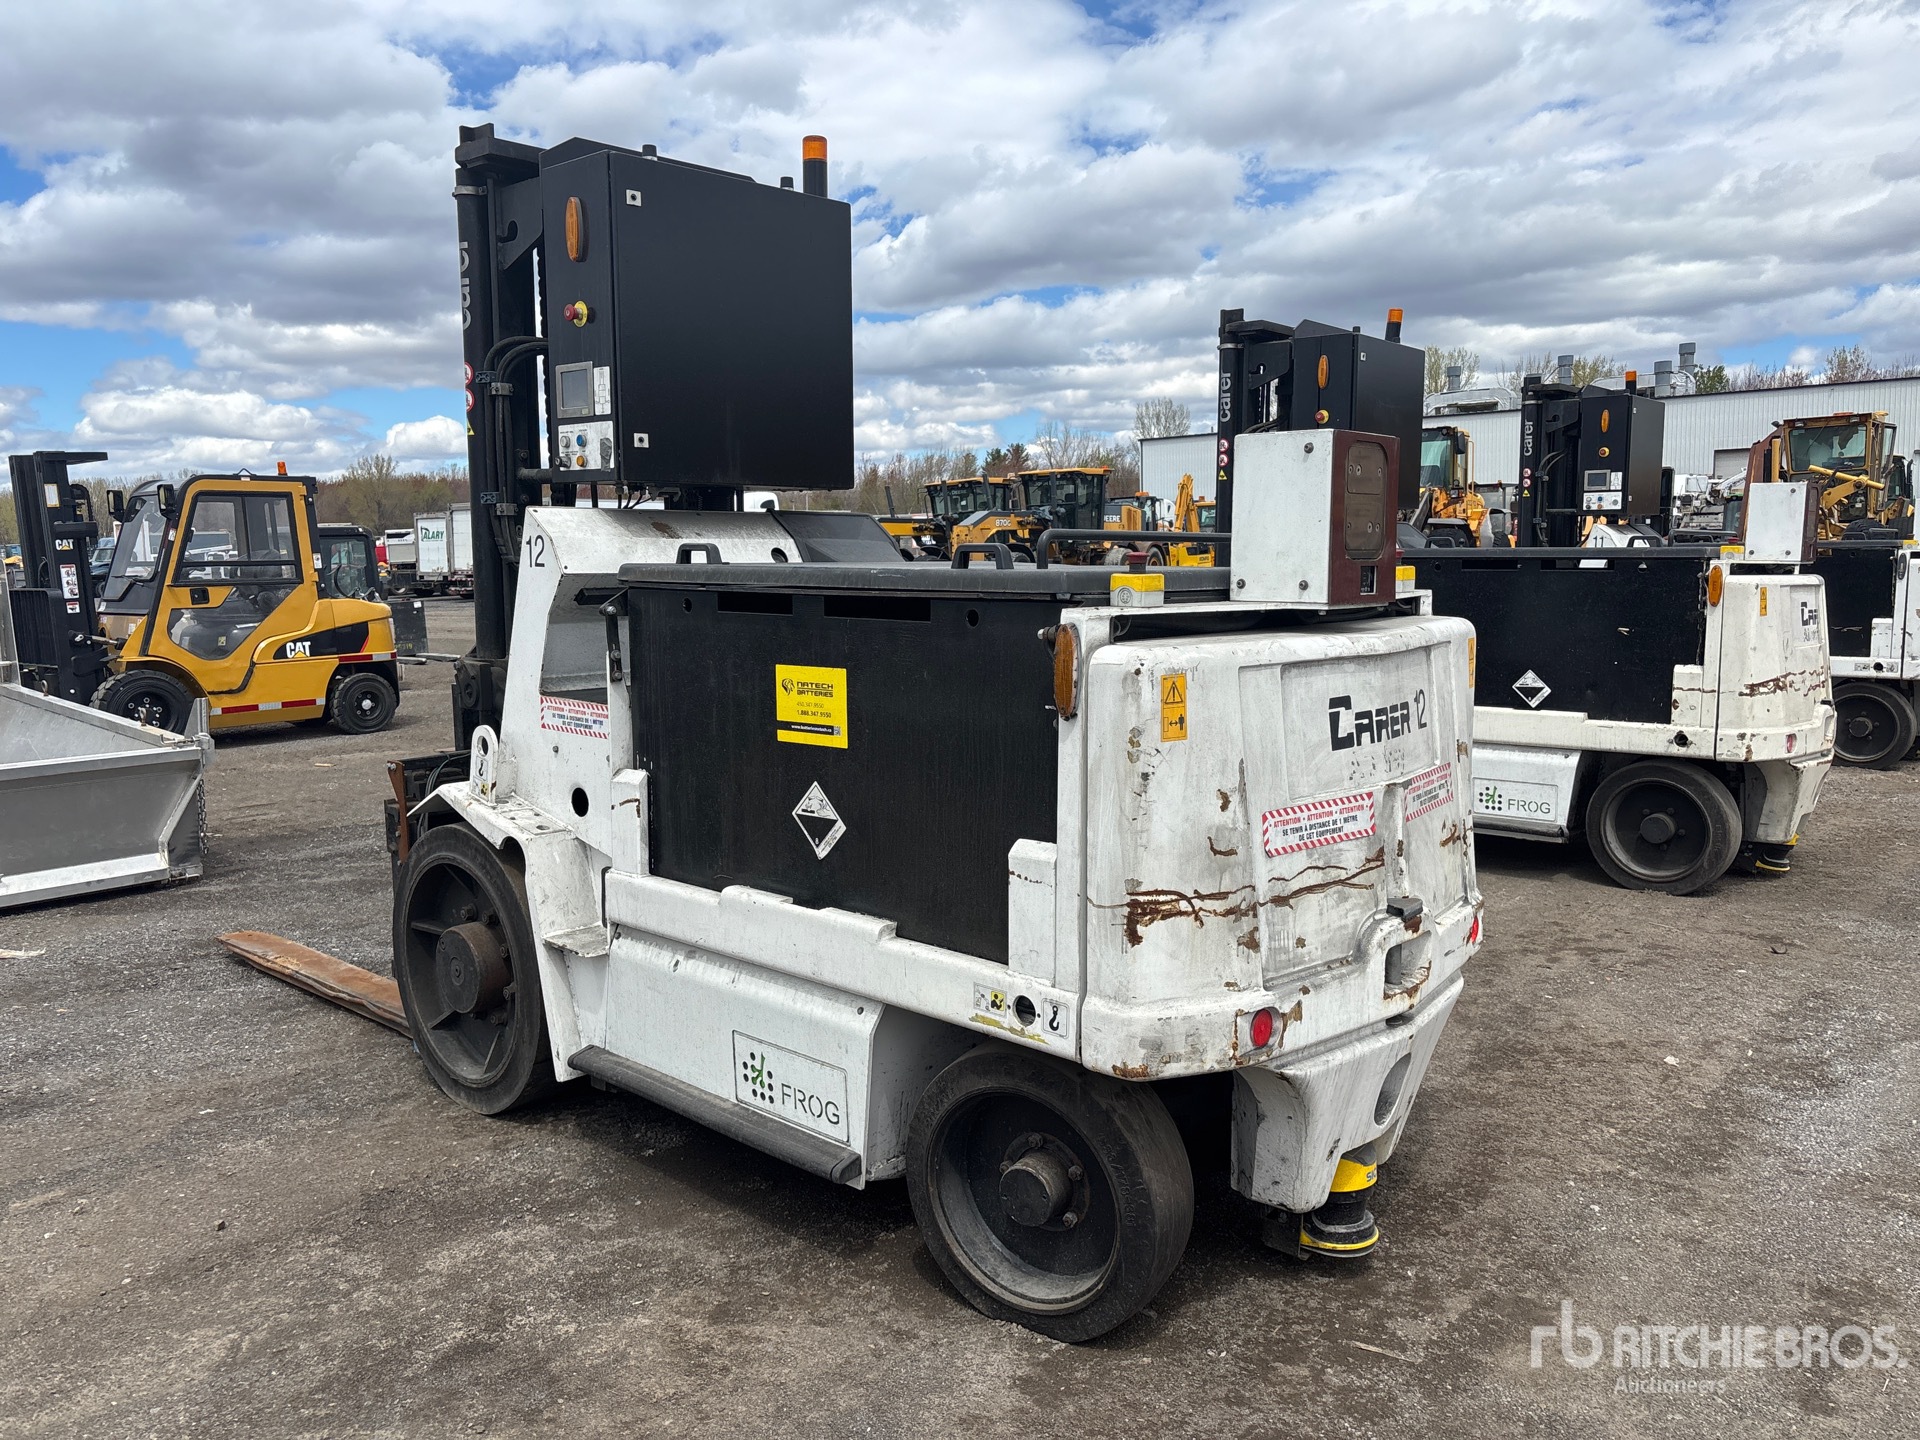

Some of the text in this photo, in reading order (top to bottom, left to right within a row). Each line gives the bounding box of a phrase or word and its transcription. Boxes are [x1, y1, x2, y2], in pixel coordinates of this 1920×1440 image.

[1219, 371, 1232, 423] carer
[1523, 420, 1534, 456] carer
[55, 539, 74, 550] CAT
[1592, 535, 1604, 547] 11
[525, 534, 546, 568] 12
[286, 641, 311, 658] CAT
[797, 681, 833, 690] NATECH
[797, 690, 834, 698] BATTERIES
[1414, 688, 1427, 730] 12
[1507, 798, 1551, 814] FROG
[1274, 804, 1364, 828] ATTENTION ATTENTION ATTENTION
[1290, 825, 1303, 834] TENIR
[1304, 823, 1309, 833] À
[1309, 820, 1331, 832] DISTANCE
[1332, 818, 1338, 826] DE
[1306, 831, 1315, 840] CET
[781, 1082, 840, 1126] FROG
